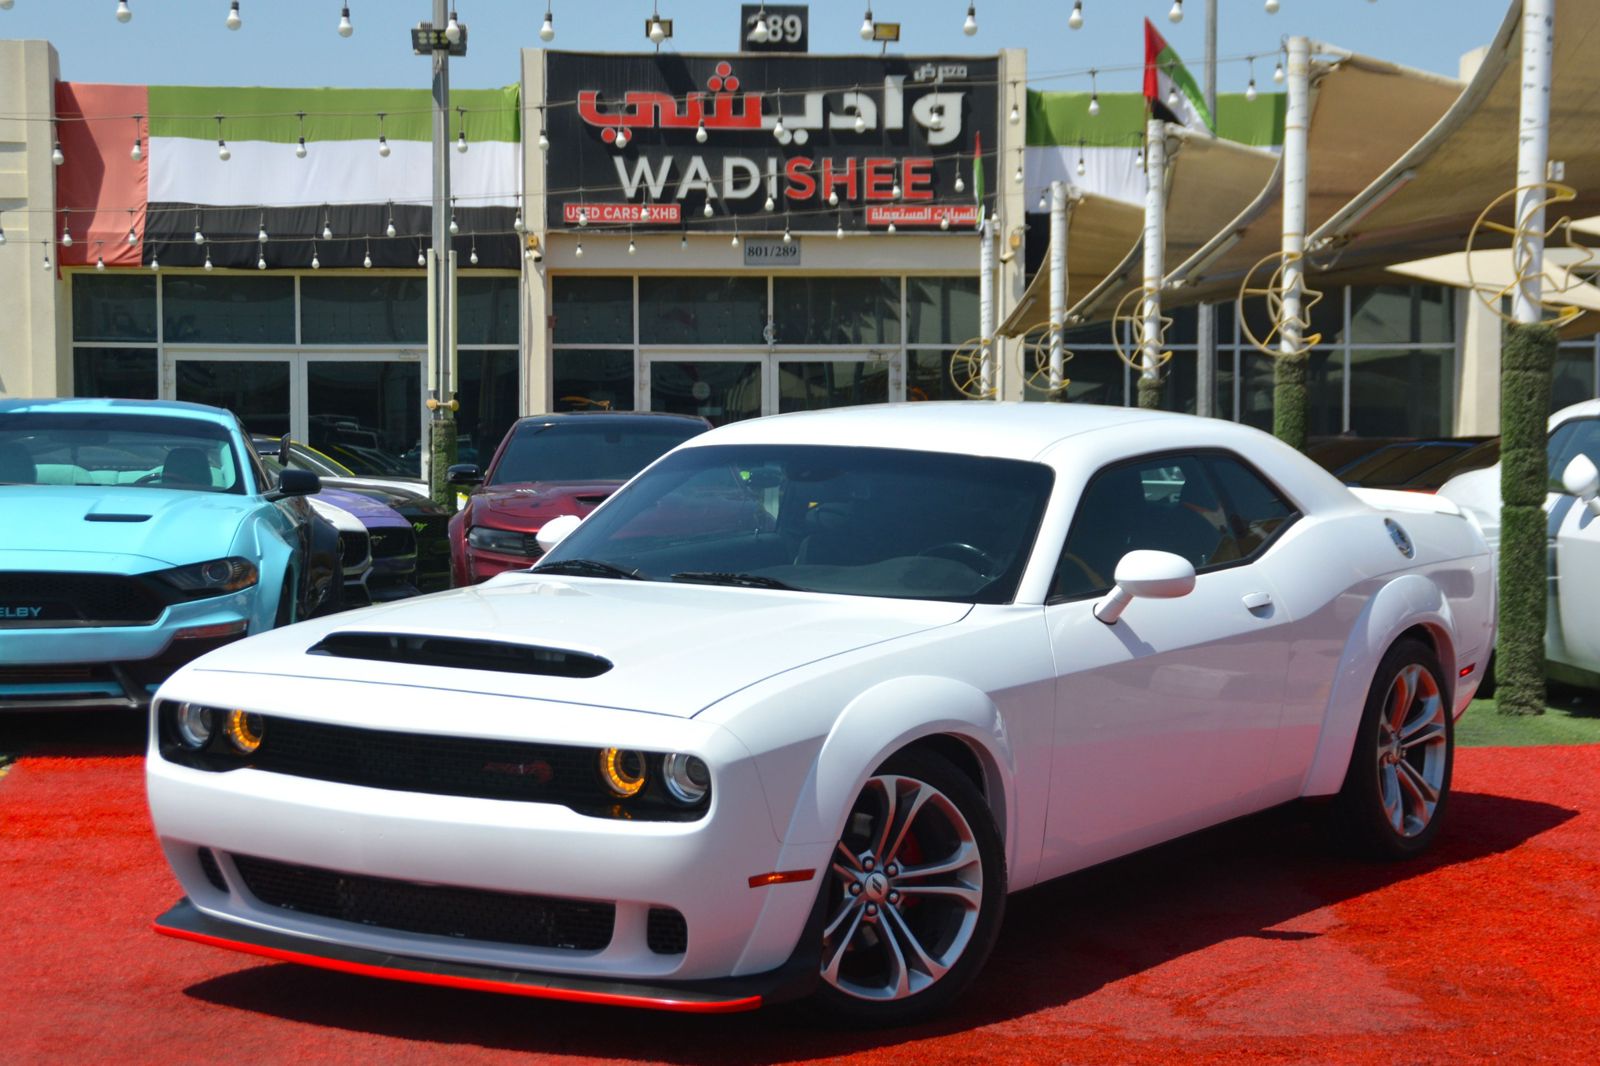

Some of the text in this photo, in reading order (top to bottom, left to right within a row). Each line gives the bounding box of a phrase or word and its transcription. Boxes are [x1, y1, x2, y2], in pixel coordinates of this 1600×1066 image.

[914, 63, 967, 84] معرض
[614, 156, 934, 200] WADISHEE
[566, 207, 600, 219] USED
[604, 207, 638, 219] CARS
[872, 207, 931, 220] المستعملة
[748, 245, 797, 257] 801/289
